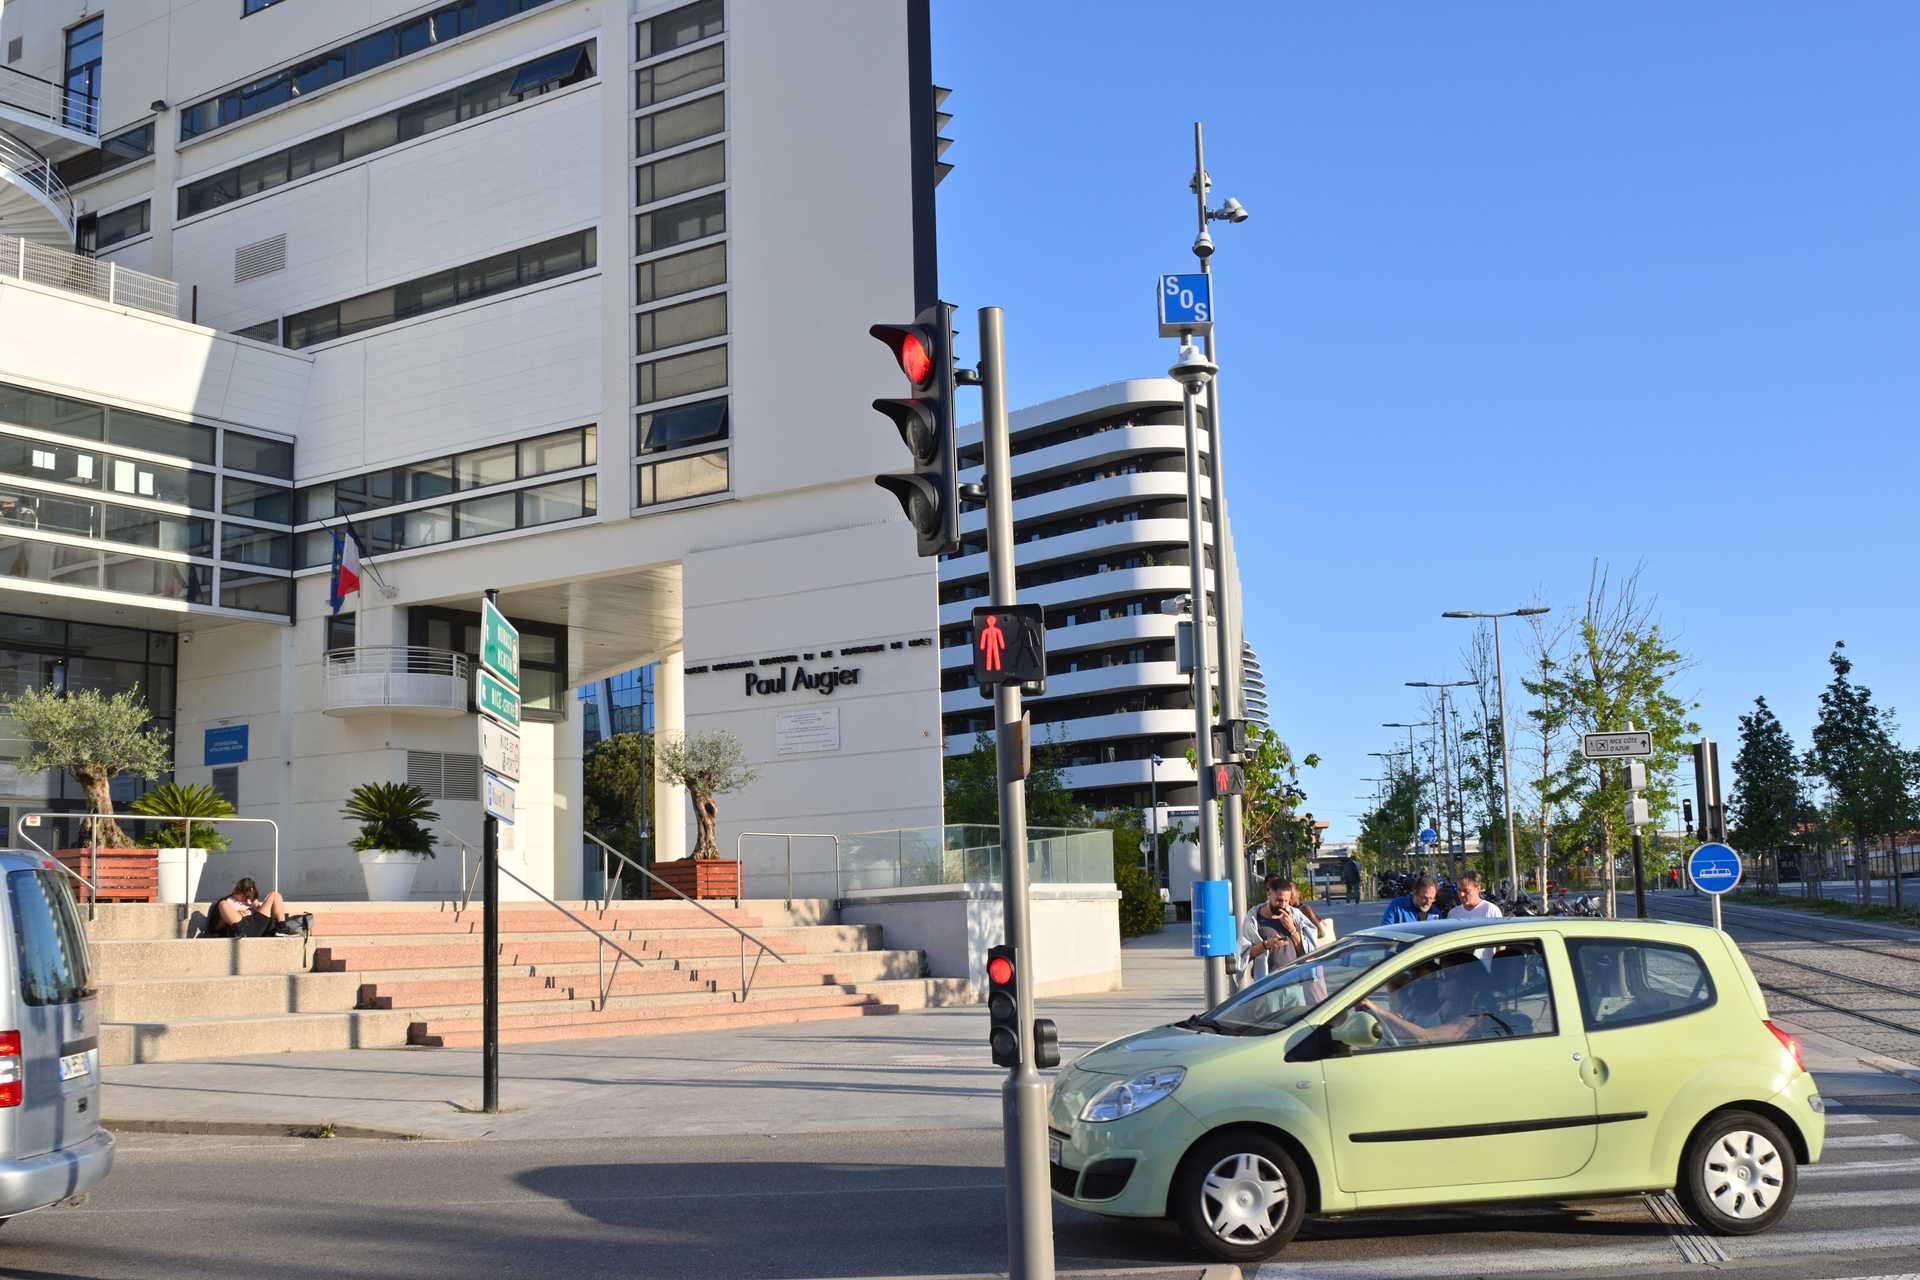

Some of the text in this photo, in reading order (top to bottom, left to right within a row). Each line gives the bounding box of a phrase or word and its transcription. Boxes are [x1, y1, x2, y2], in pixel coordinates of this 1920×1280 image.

[1166, 276, 1208, 321] SOS
[745, 666, 861, 696] Paul Augier
